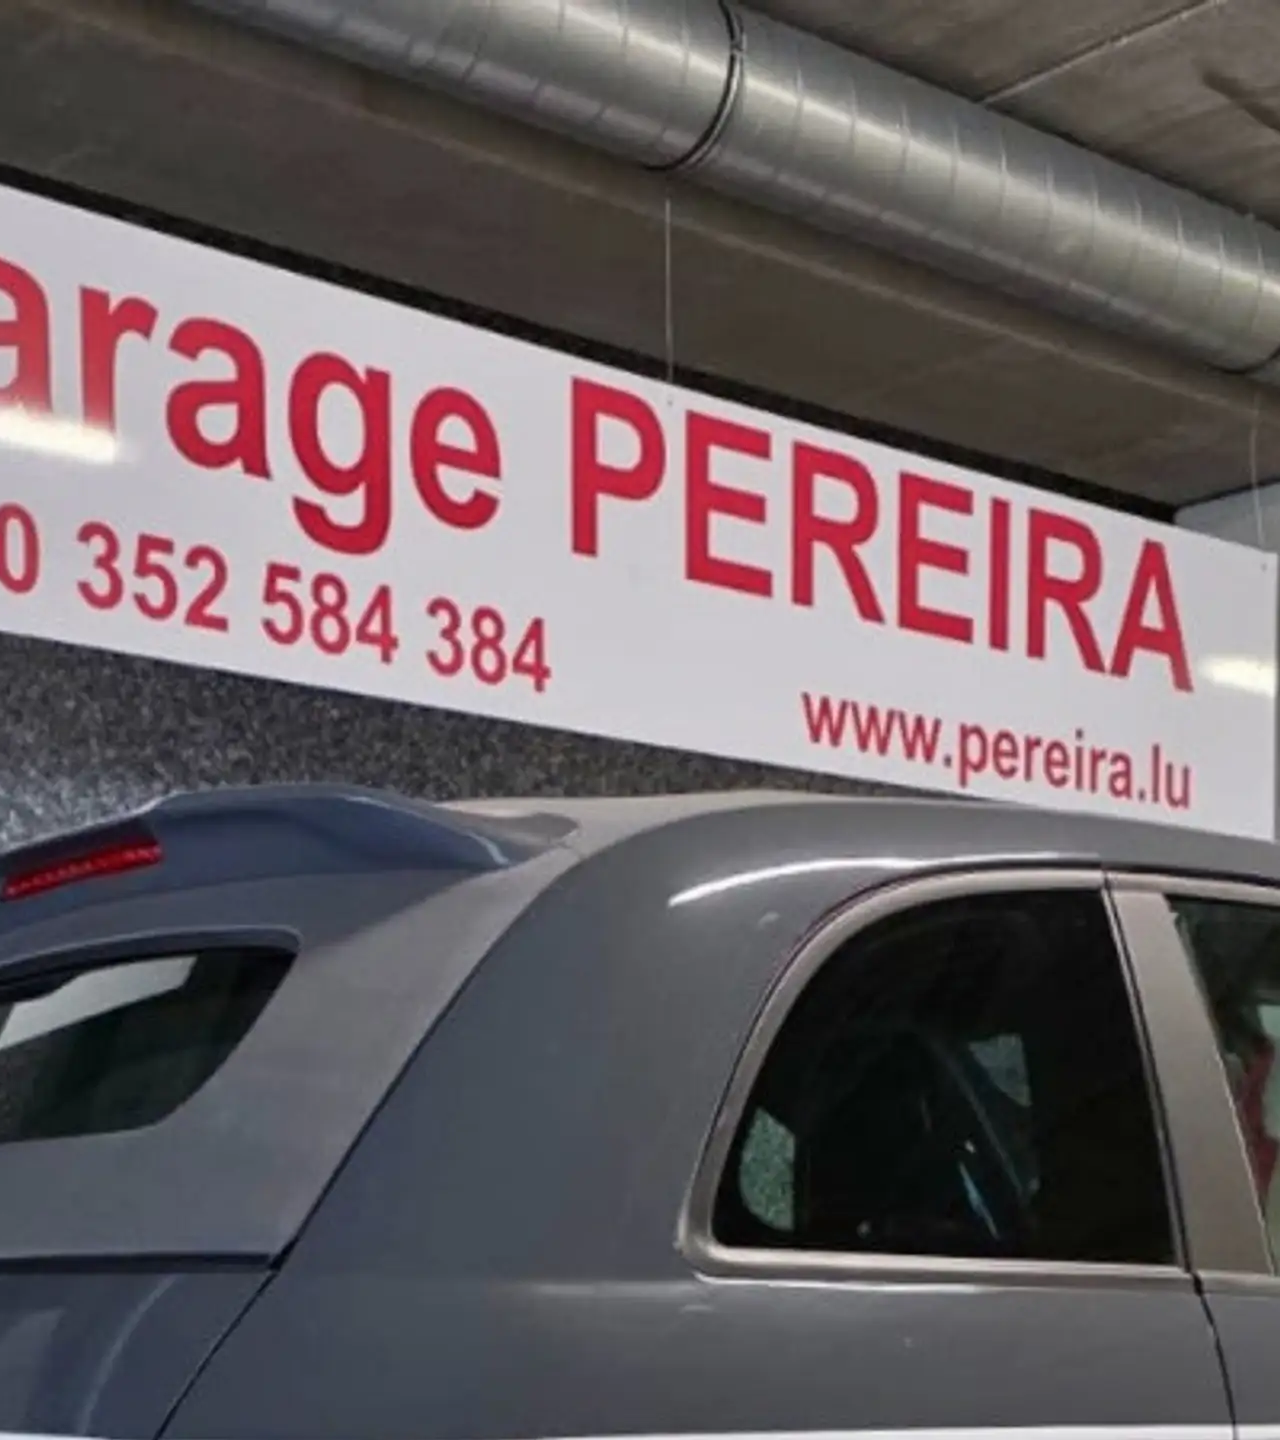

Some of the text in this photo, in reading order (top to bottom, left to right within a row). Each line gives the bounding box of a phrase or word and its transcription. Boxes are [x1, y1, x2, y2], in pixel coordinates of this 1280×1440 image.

[76, 520, 230, 632] 352
[261, 561, 400, 665] 584
[425, 596, 552, 693] 384
[570, 376, 1194, 692] PEREIRA
[801, 691, 1193, 811] www.pereira.lu
